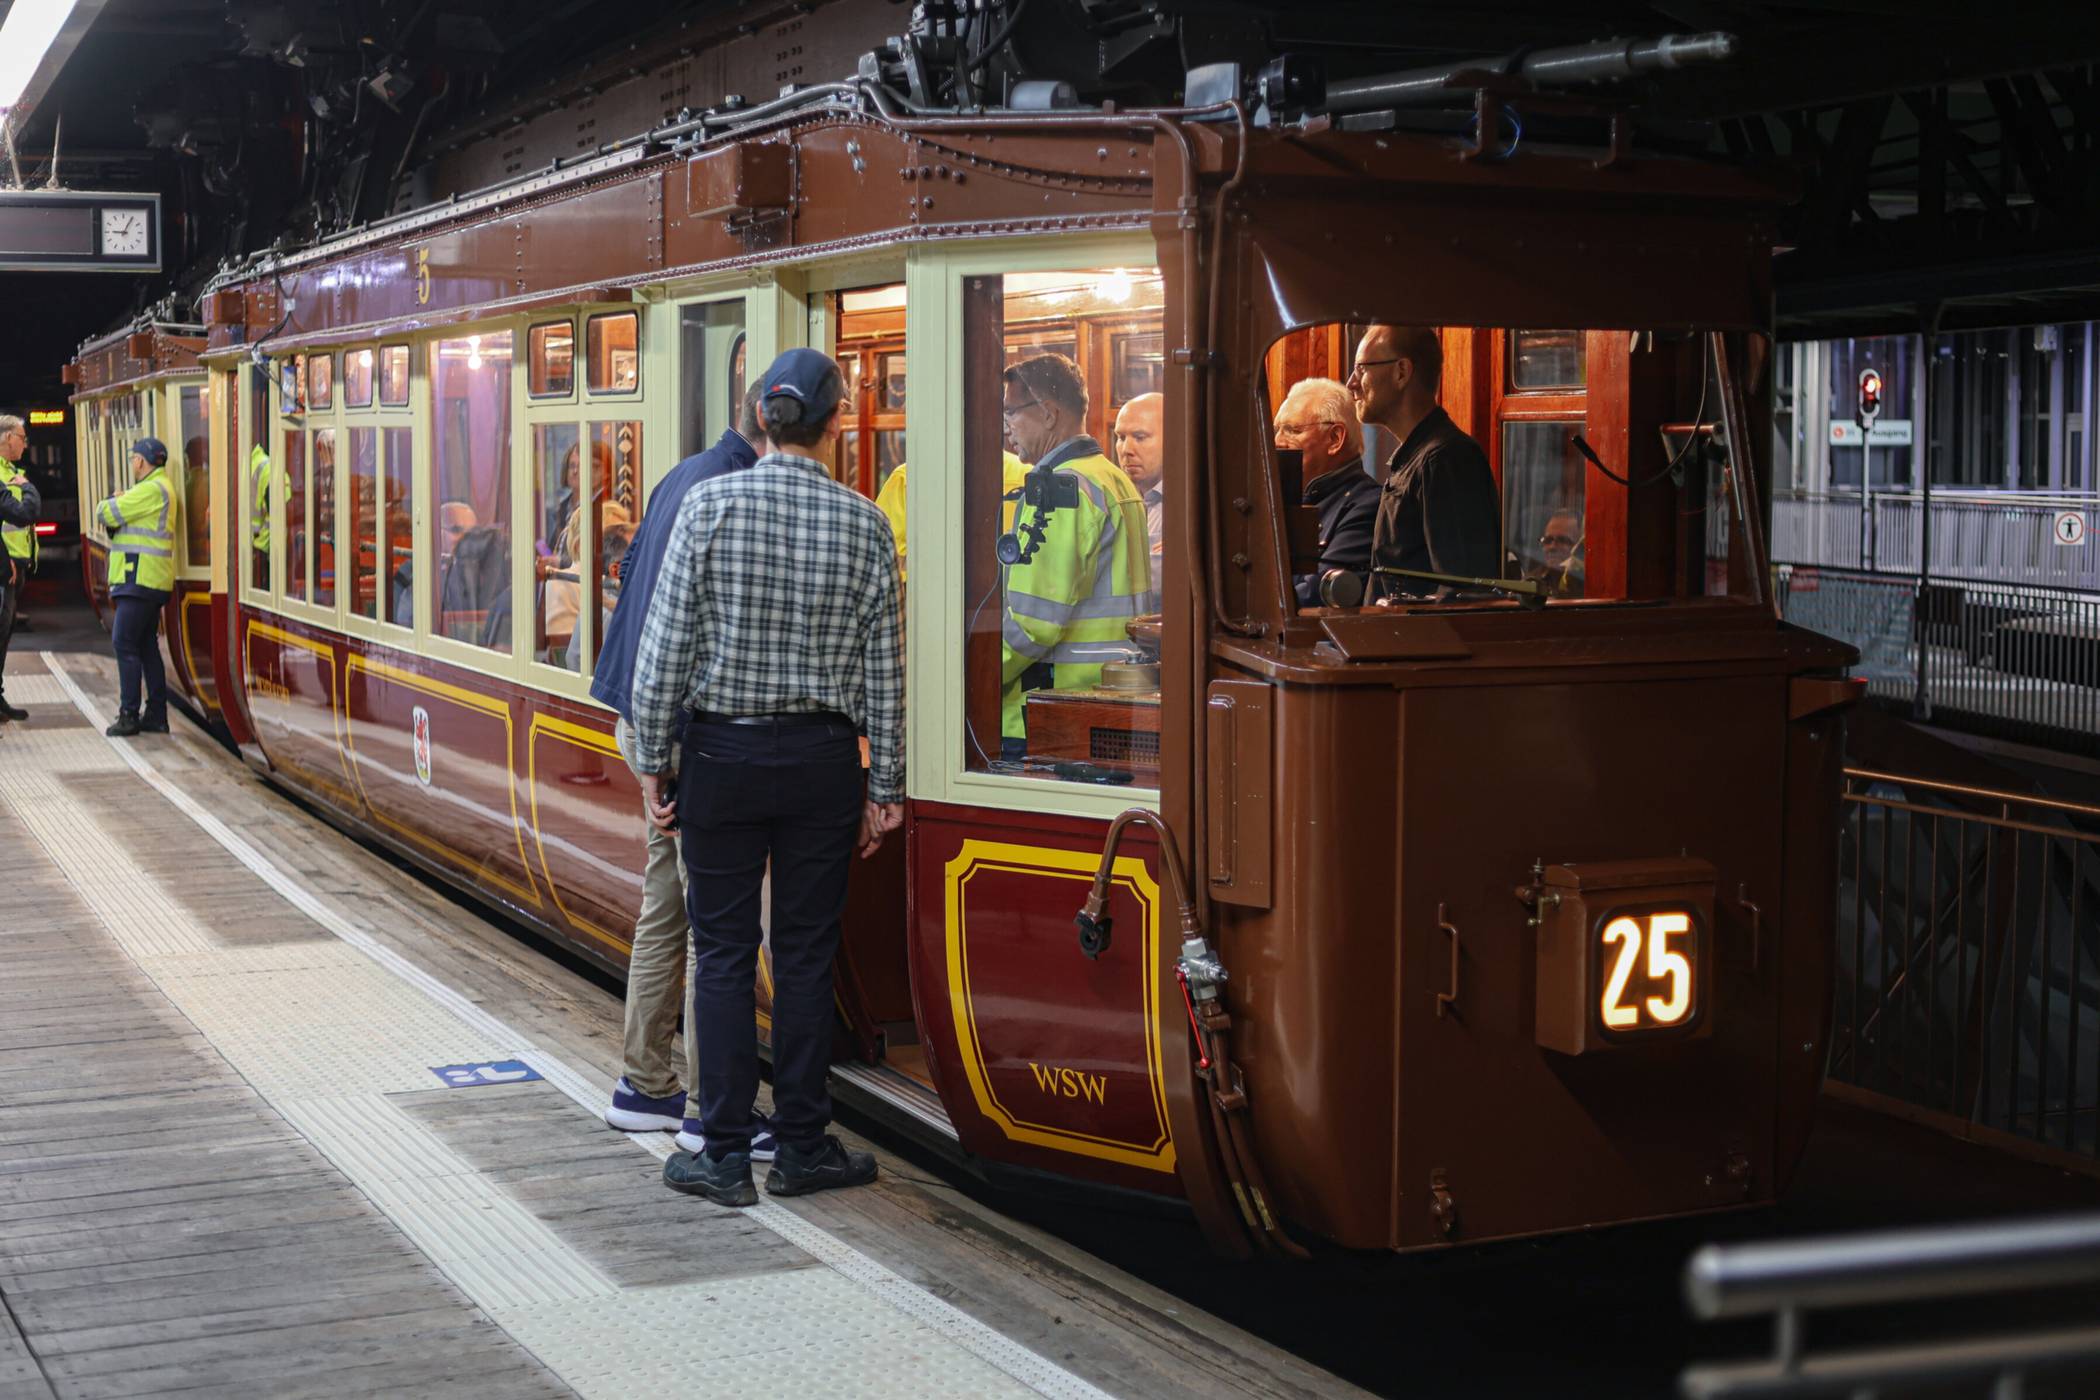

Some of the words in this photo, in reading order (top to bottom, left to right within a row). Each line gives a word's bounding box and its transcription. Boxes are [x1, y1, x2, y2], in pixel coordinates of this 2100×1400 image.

[419, 247, 430, 304] 5
[1601, 912, 1691, 1026] 25
[1028, 1062, 1107, 1105] WSW
